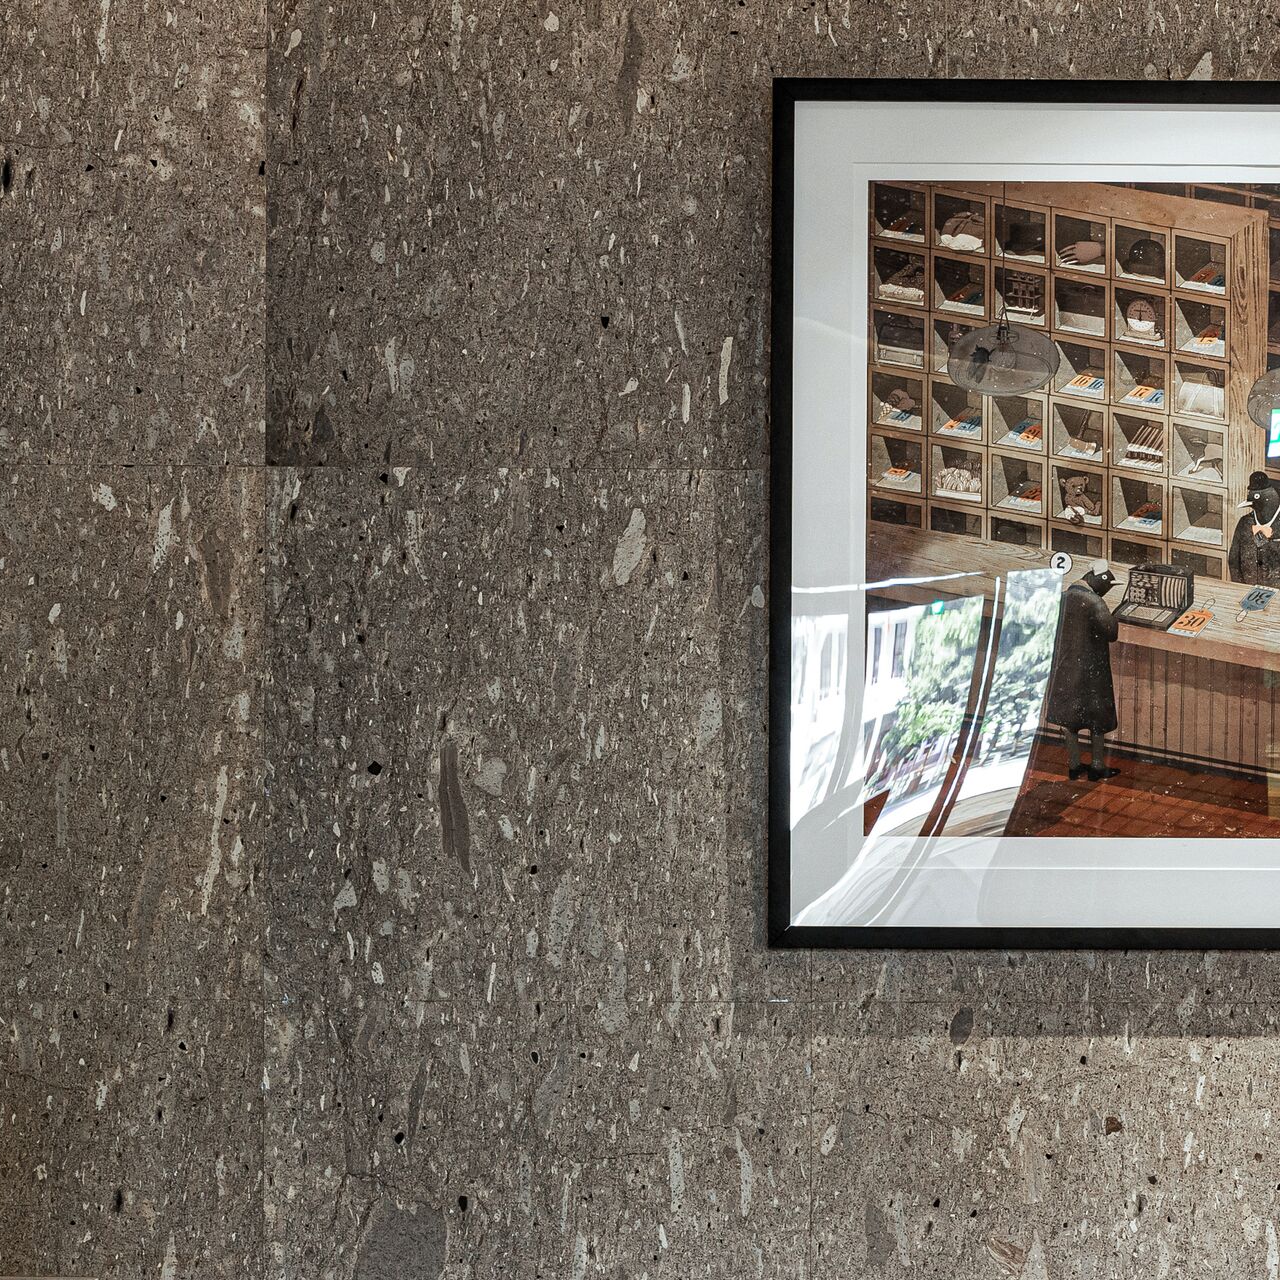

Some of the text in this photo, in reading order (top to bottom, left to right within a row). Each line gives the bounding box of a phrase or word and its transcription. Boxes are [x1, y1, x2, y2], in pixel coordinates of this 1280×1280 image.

[1073, 376, 1105, 389] 16 16
[1133, 387, 1149, 397] 17
[1057, 556, 1066, 569] 2
[1177, 613, 1206, 629] 30
